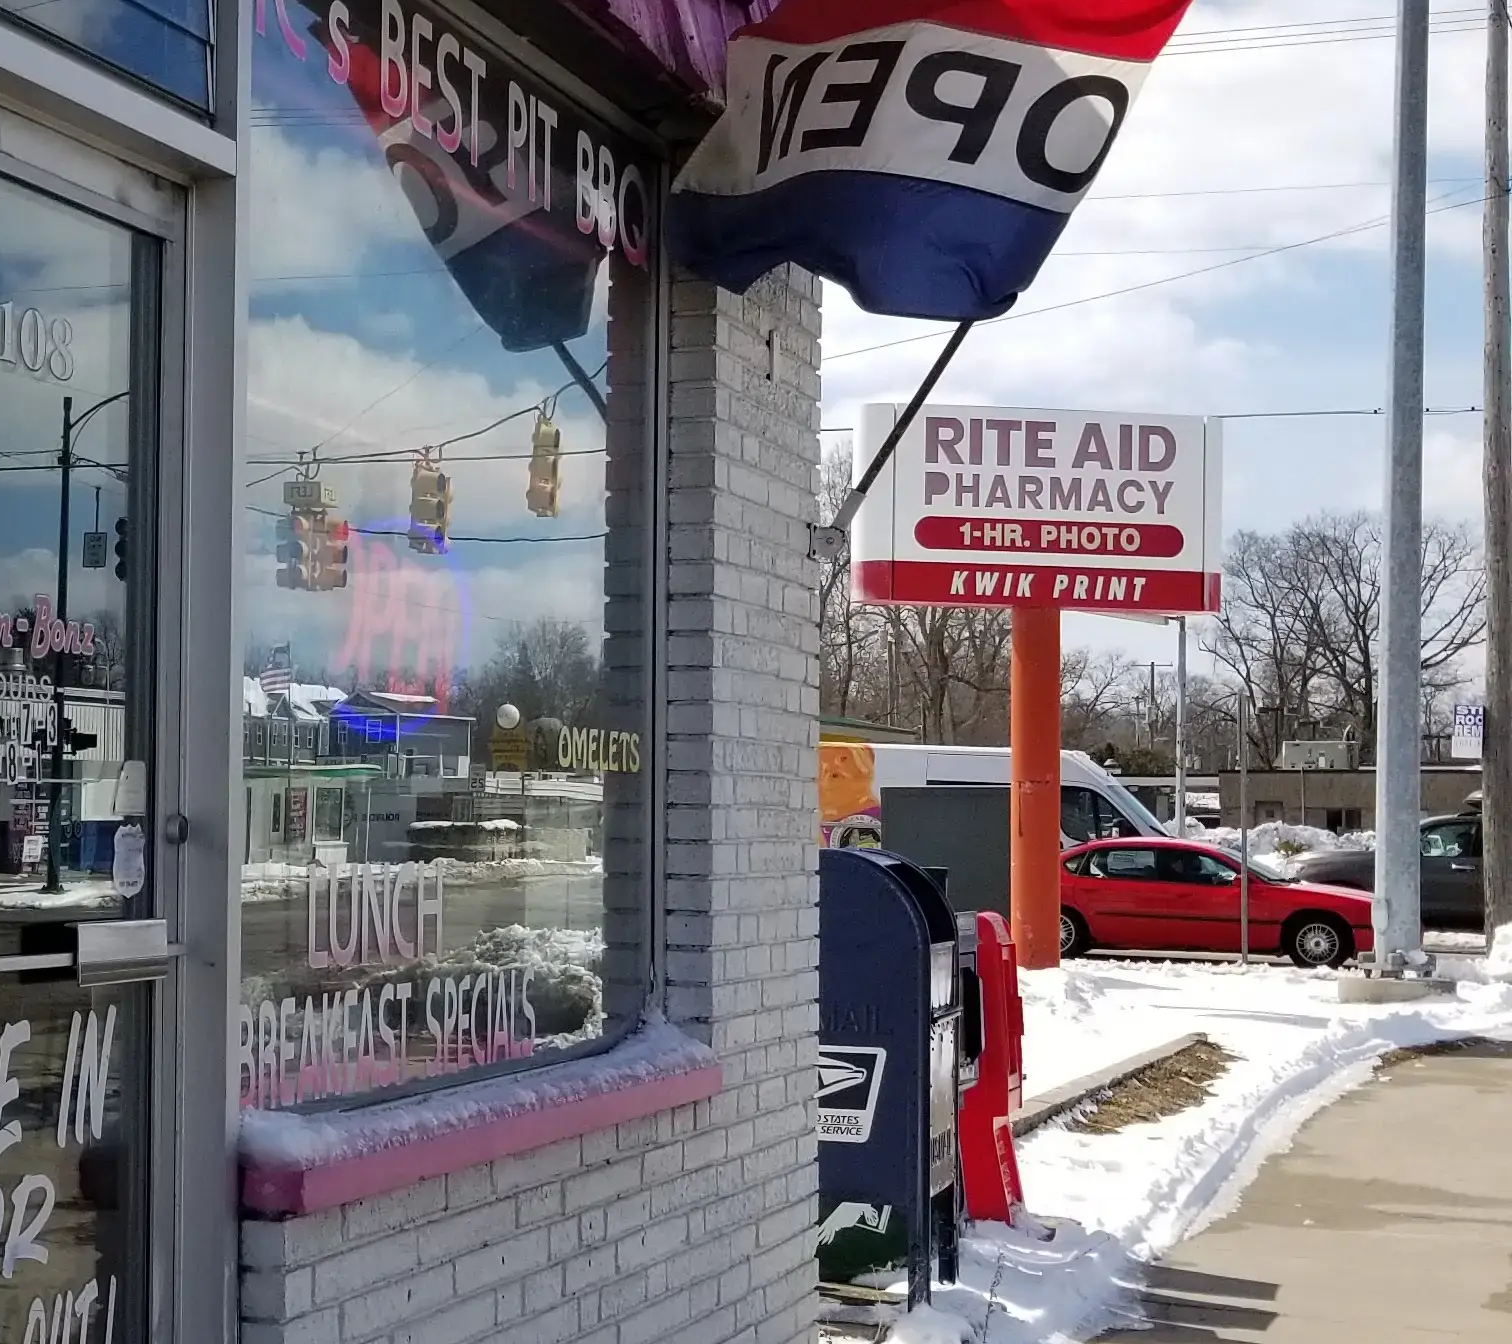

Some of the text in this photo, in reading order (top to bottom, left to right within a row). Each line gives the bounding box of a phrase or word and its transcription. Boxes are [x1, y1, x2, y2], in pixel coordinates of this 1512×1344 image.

[507, 80, 558, 213] PIT
[576, 129, 649, 267] BBQ
[924, 416, 1177, 472] RITE AID
[924, 471, 1175, 515] PHARMACY
[959, 521, 1141, 552] 1-HR. PHOTO
[949, 570, 1147, 602] KWIK PRINT
[557, 725, 640, 773] OMELETS
[308, 859, 443, 970] LUNCH
[240, 969, 536, 1109] BREAKFAST SPECIALS
[56, 1004, 117, 1149] IN
[820, 1125, 863, 1136] SERVICE
[823, 1114, 860, 1125] STATES
